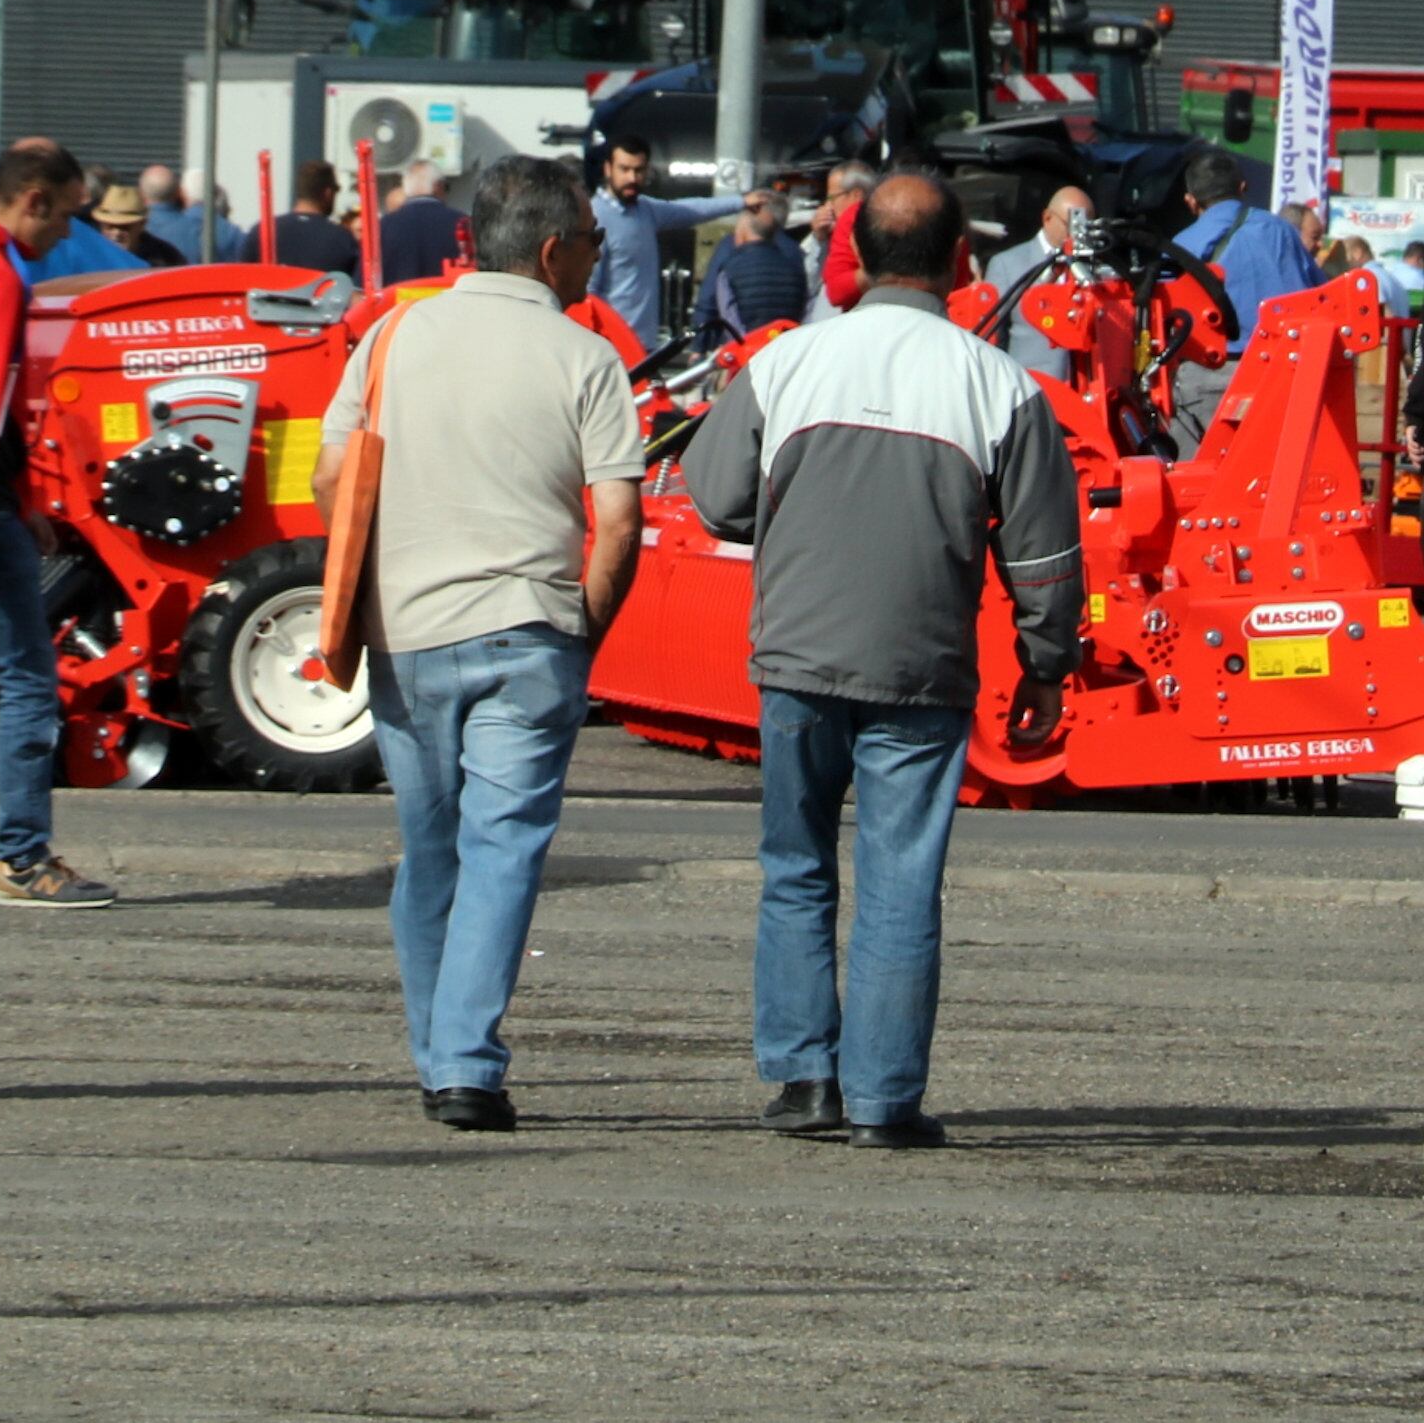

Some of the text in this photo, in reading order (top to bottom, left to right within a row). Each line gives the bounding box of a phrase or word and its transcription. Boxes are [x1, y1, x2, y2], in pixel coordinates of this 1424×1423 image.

[86, 314, 245, 338] TALLERS BERGA
[125, 347, 263, 376] GASPARDO
[1256, 609, 1337, 626] MASCHIO
[1219, 741, 1302, 763] TALLERS
[1306, 737, 1375, 757] BERGA
